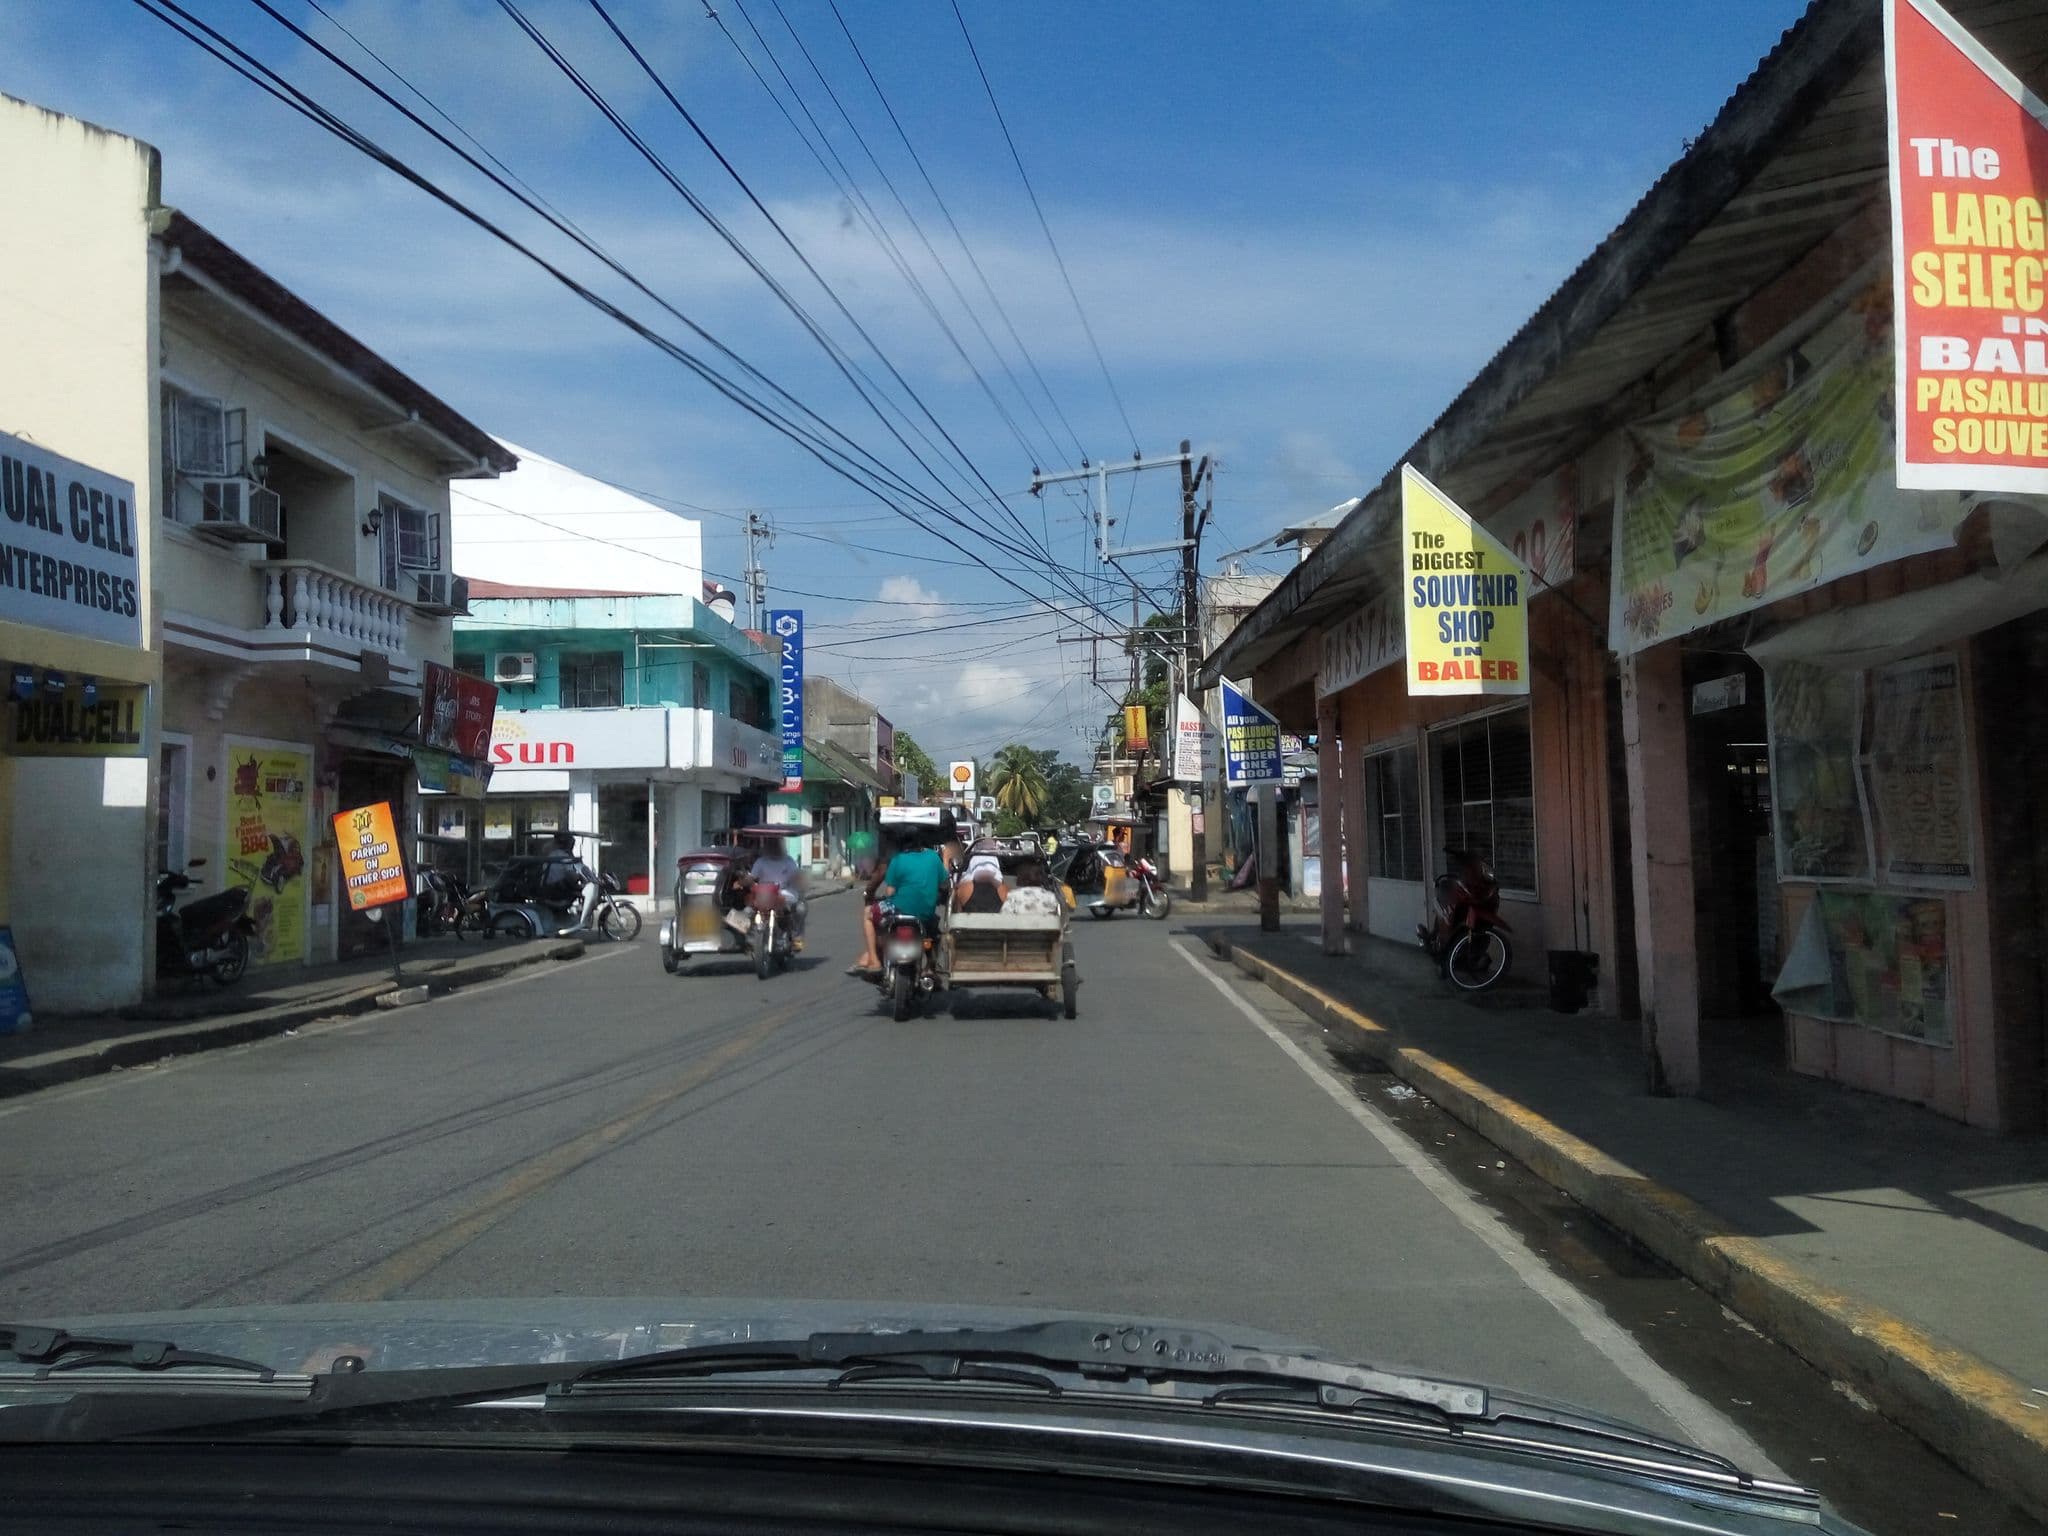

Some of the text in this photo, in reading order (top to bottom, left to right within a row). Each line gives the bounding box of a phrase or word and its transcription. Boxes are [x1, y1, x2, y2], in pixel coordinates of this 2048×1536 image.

[1910, 138, 2000, 181] The
[1932, 192, 2048, 252] LARG
[1911, 252, 2048, 313] SELEC
[1920, 336, 2048, 375] BAL
[1916, 378, 2048, 417] PASALU
[1932, 417, 2048, 457] SOUVE
[0, 455, 134, 558] UAL CELL
[1412, 531, 1445, 549] The
[1412, 551, 1485, 571] BIGGEST
[1413, 574, 1518, 608] SOUVENIR
[1438, 610, 1495, 643] SHOP
[1453, 646, 1483, 656] IN
[1418, 660, 1519, 681] BALER
[1227, 715, 1259, 725] All your
[1227, 725, 1277, 739] PASALUBONG
[1229, 738, 1276, 752] NEEDS
[1230, 751, 1277, 762] UNDER
[1240, 760, 1268, 770] ONE
[1236, 768, 1273, 779] ROOF
[360, 834, 373, 845] NO
[351, 844, 388, 860] PARKING
[366, 859, 378, 870] ON
[350, 866, 401, 887] EITHER SIDE
